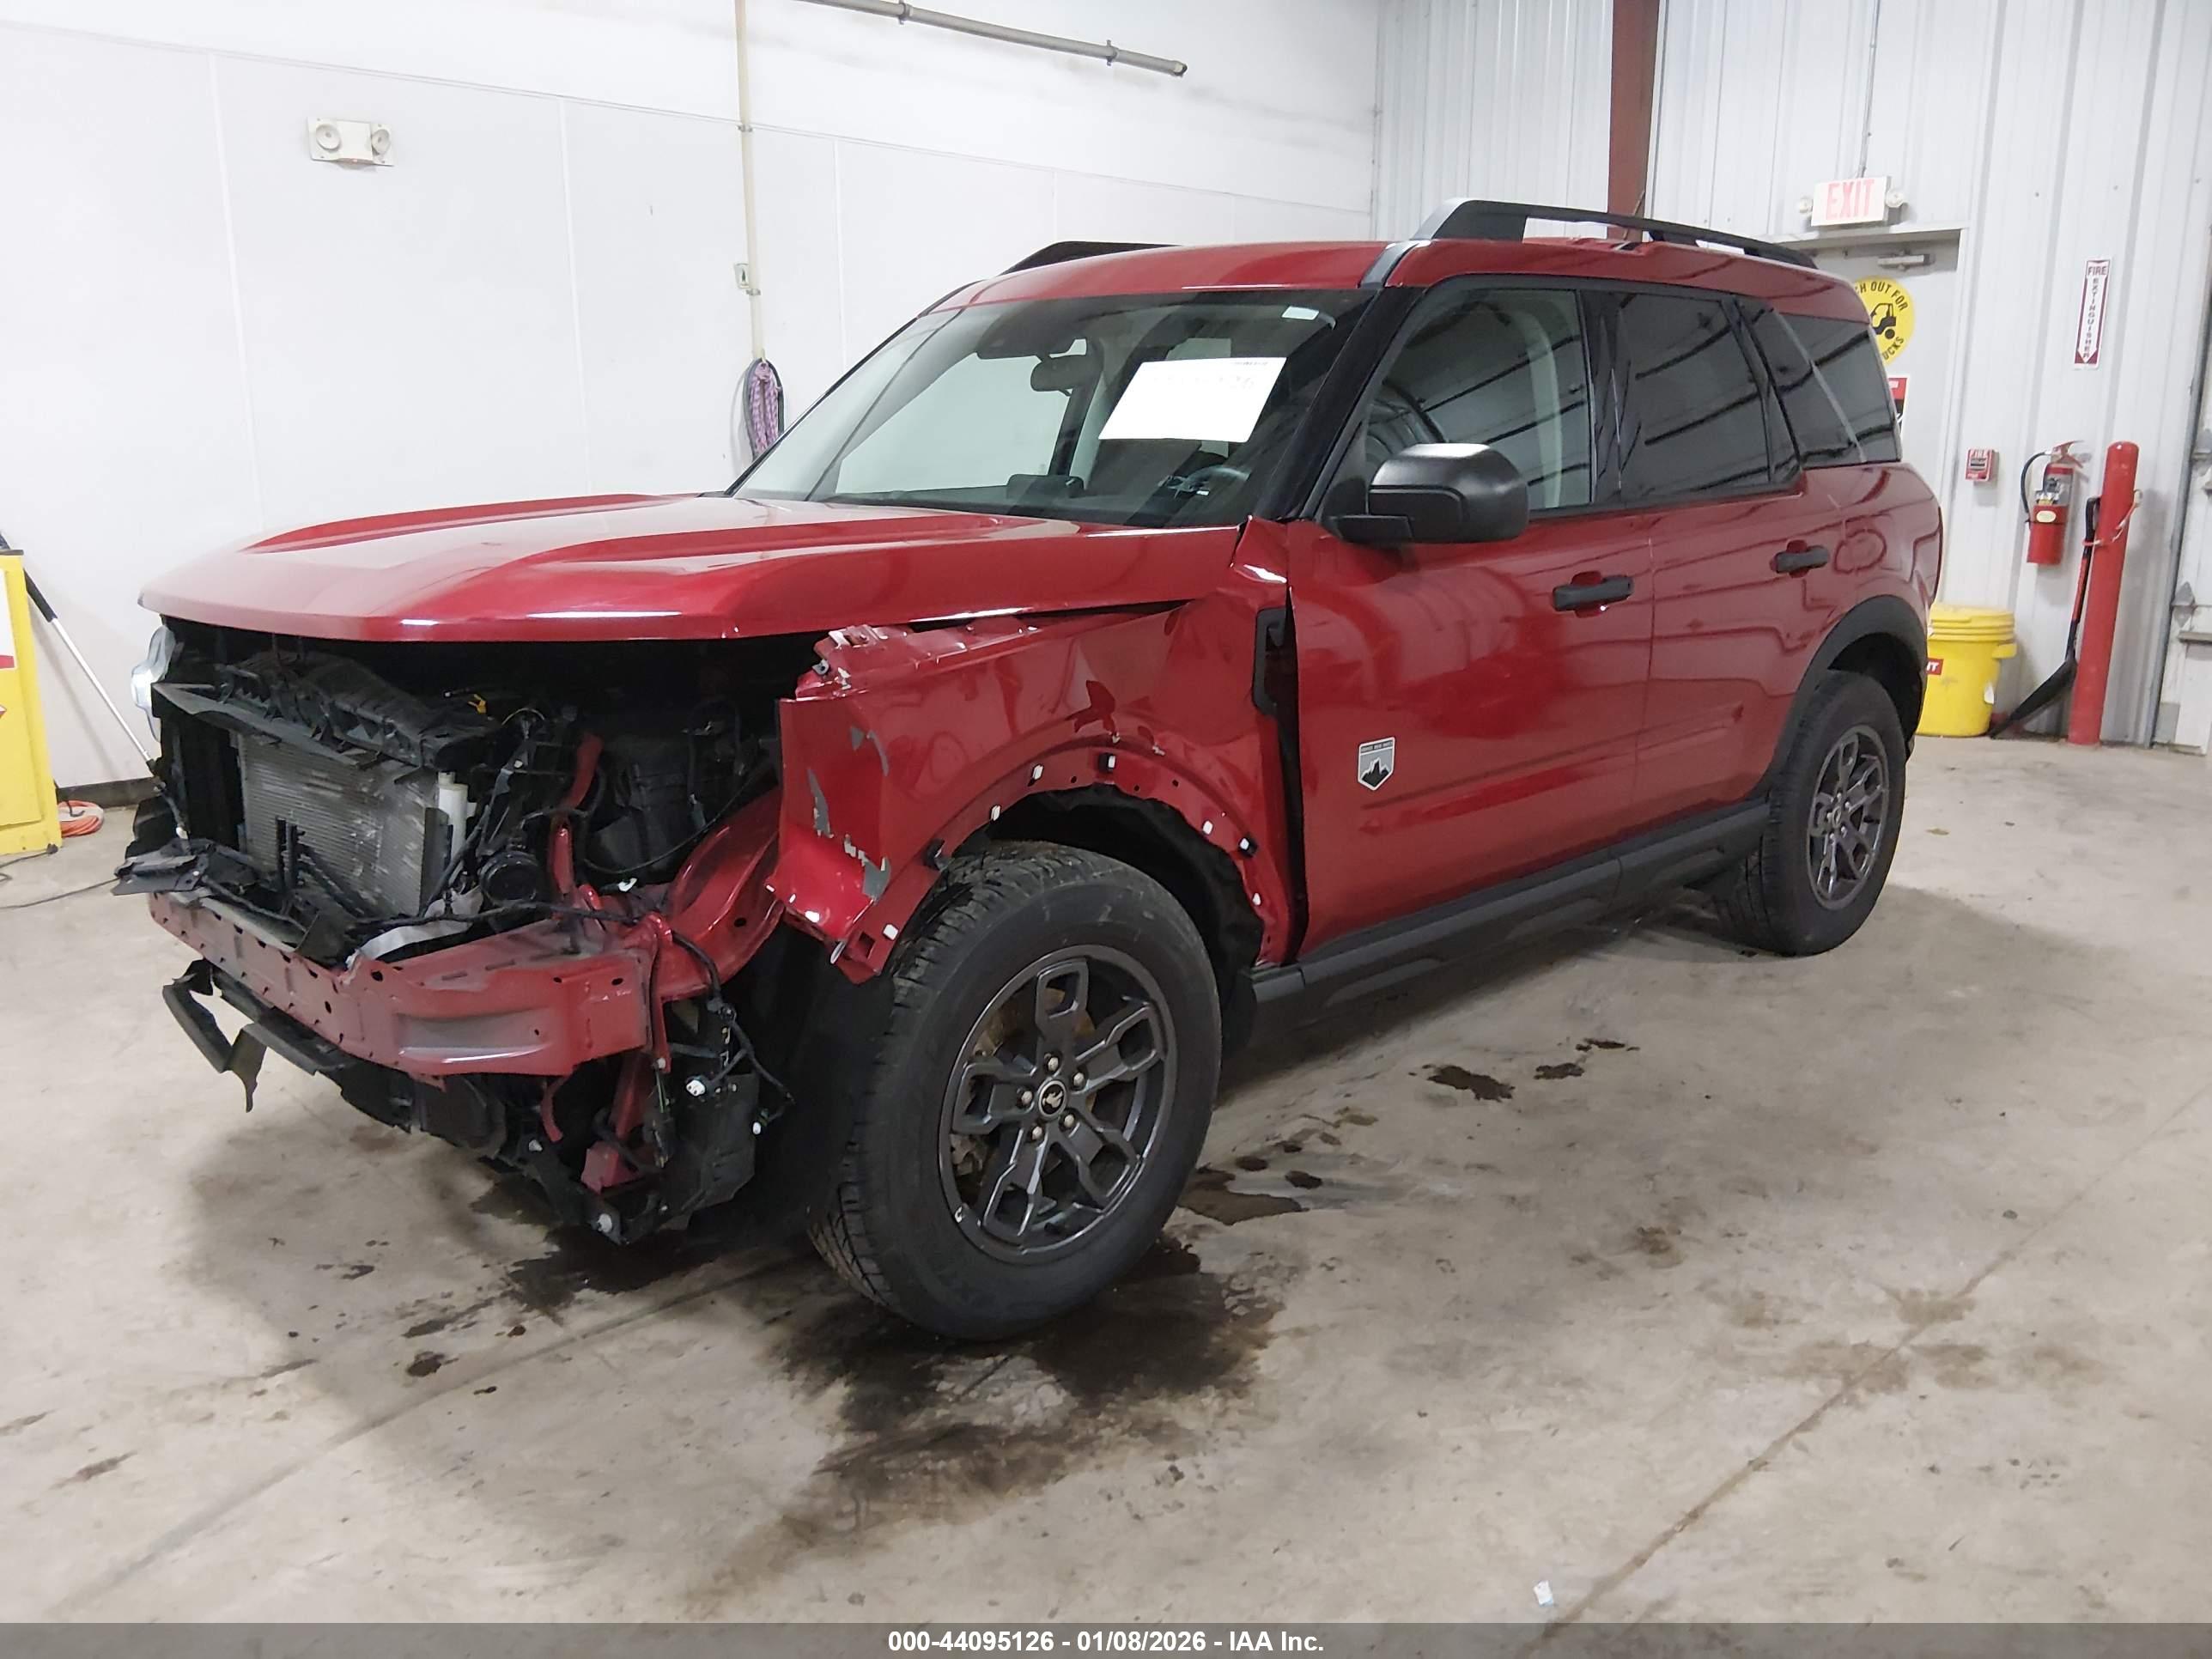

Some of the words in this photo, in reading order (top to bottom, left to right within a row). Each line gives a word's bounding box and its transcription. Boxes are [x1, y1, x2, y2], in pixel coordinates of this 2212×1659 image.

[1826, 179, 1875, 221] EXIT
[2087, 265, 2106, 276] FIRE
[1870, 281, 1892, 294] OUT
[1890, 289, 1908, 311] FOR
[2083, 277, 2099, 358] EXTINGUISHER
[1881, 336, 1905, 361] UCKS
